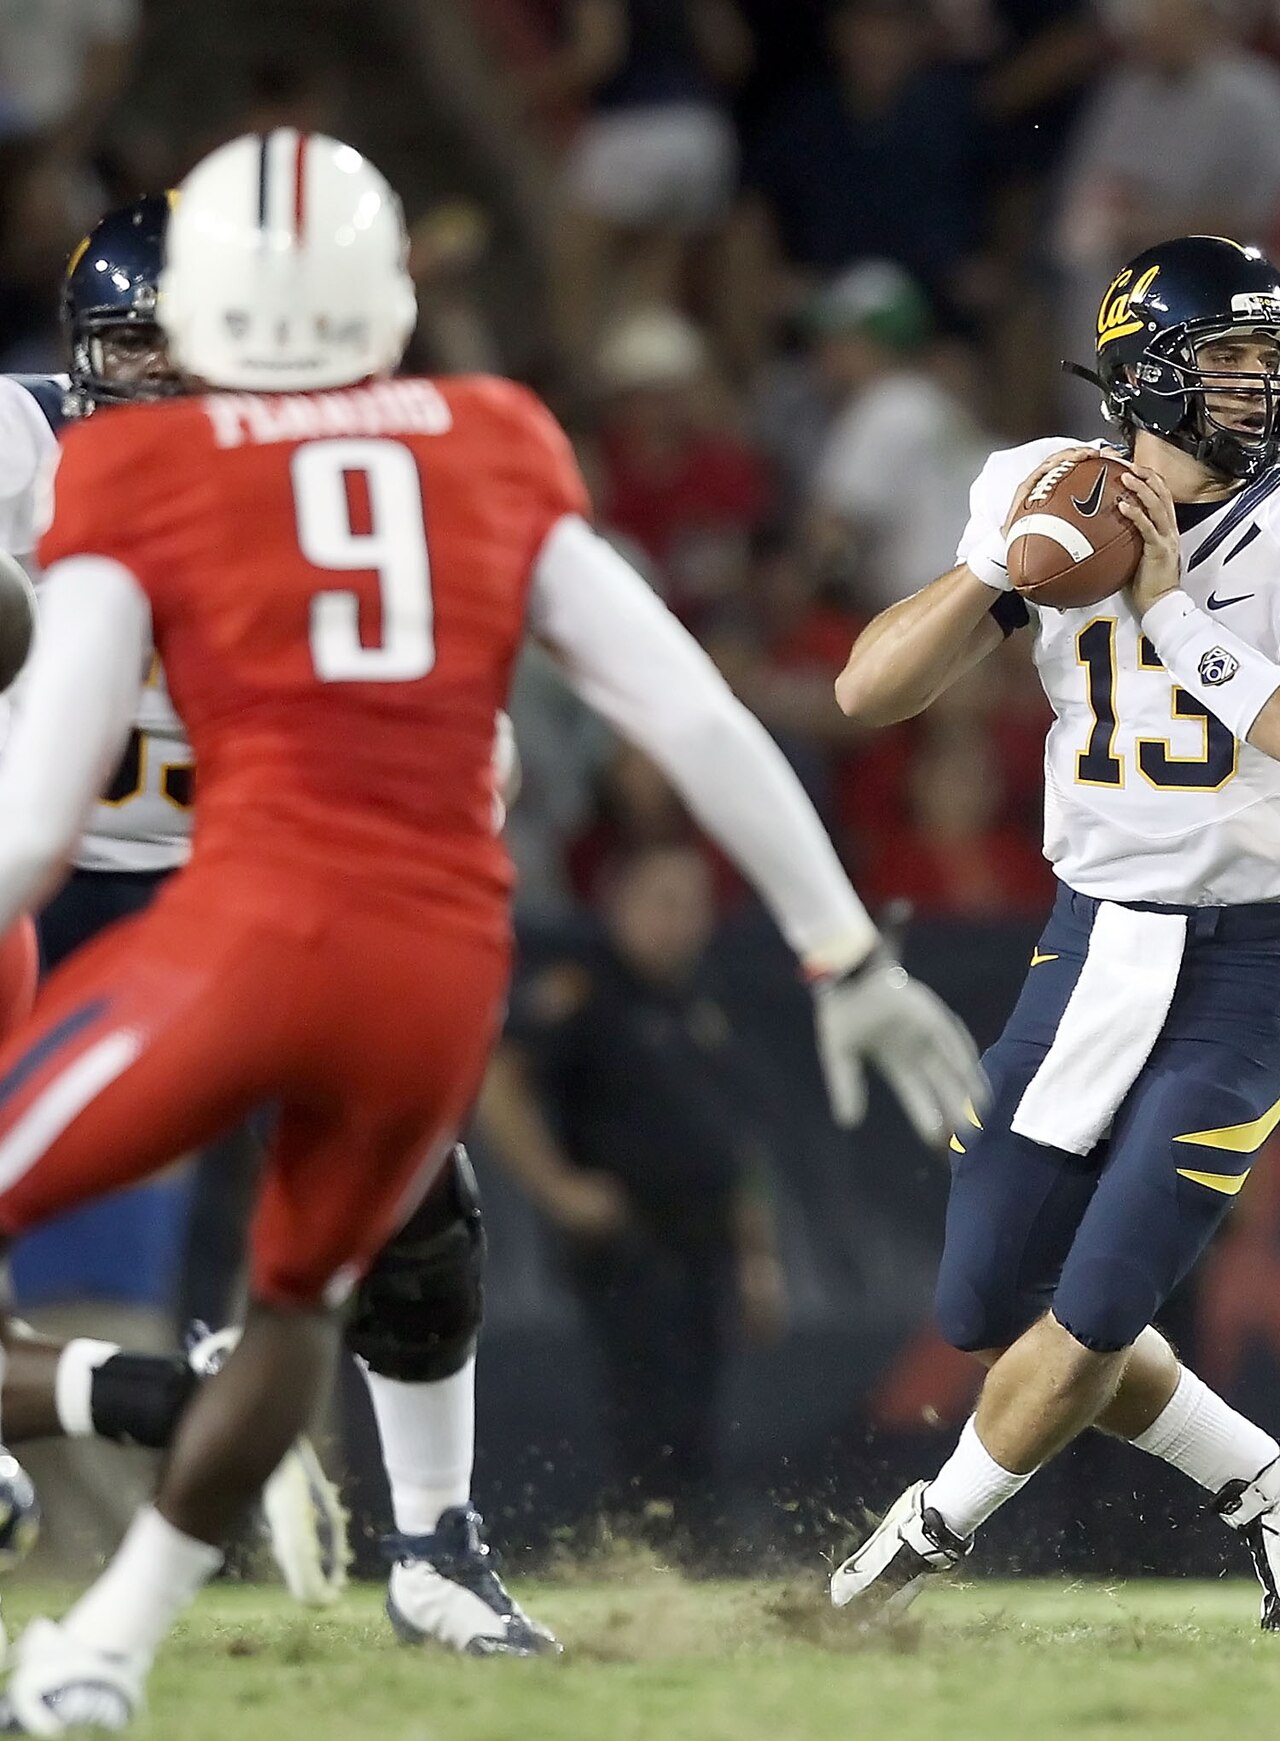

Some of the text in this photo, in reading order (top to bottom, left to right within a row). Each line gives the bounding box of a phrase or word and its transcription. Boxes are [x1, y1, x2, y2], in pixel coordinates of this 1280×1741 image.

[1097, 265, 1160, 345] Cal
[290, 438, 435, 682] 9
[1074, 616, 1241, 792] 13
[1203, 648, 1239, 680] PAC
